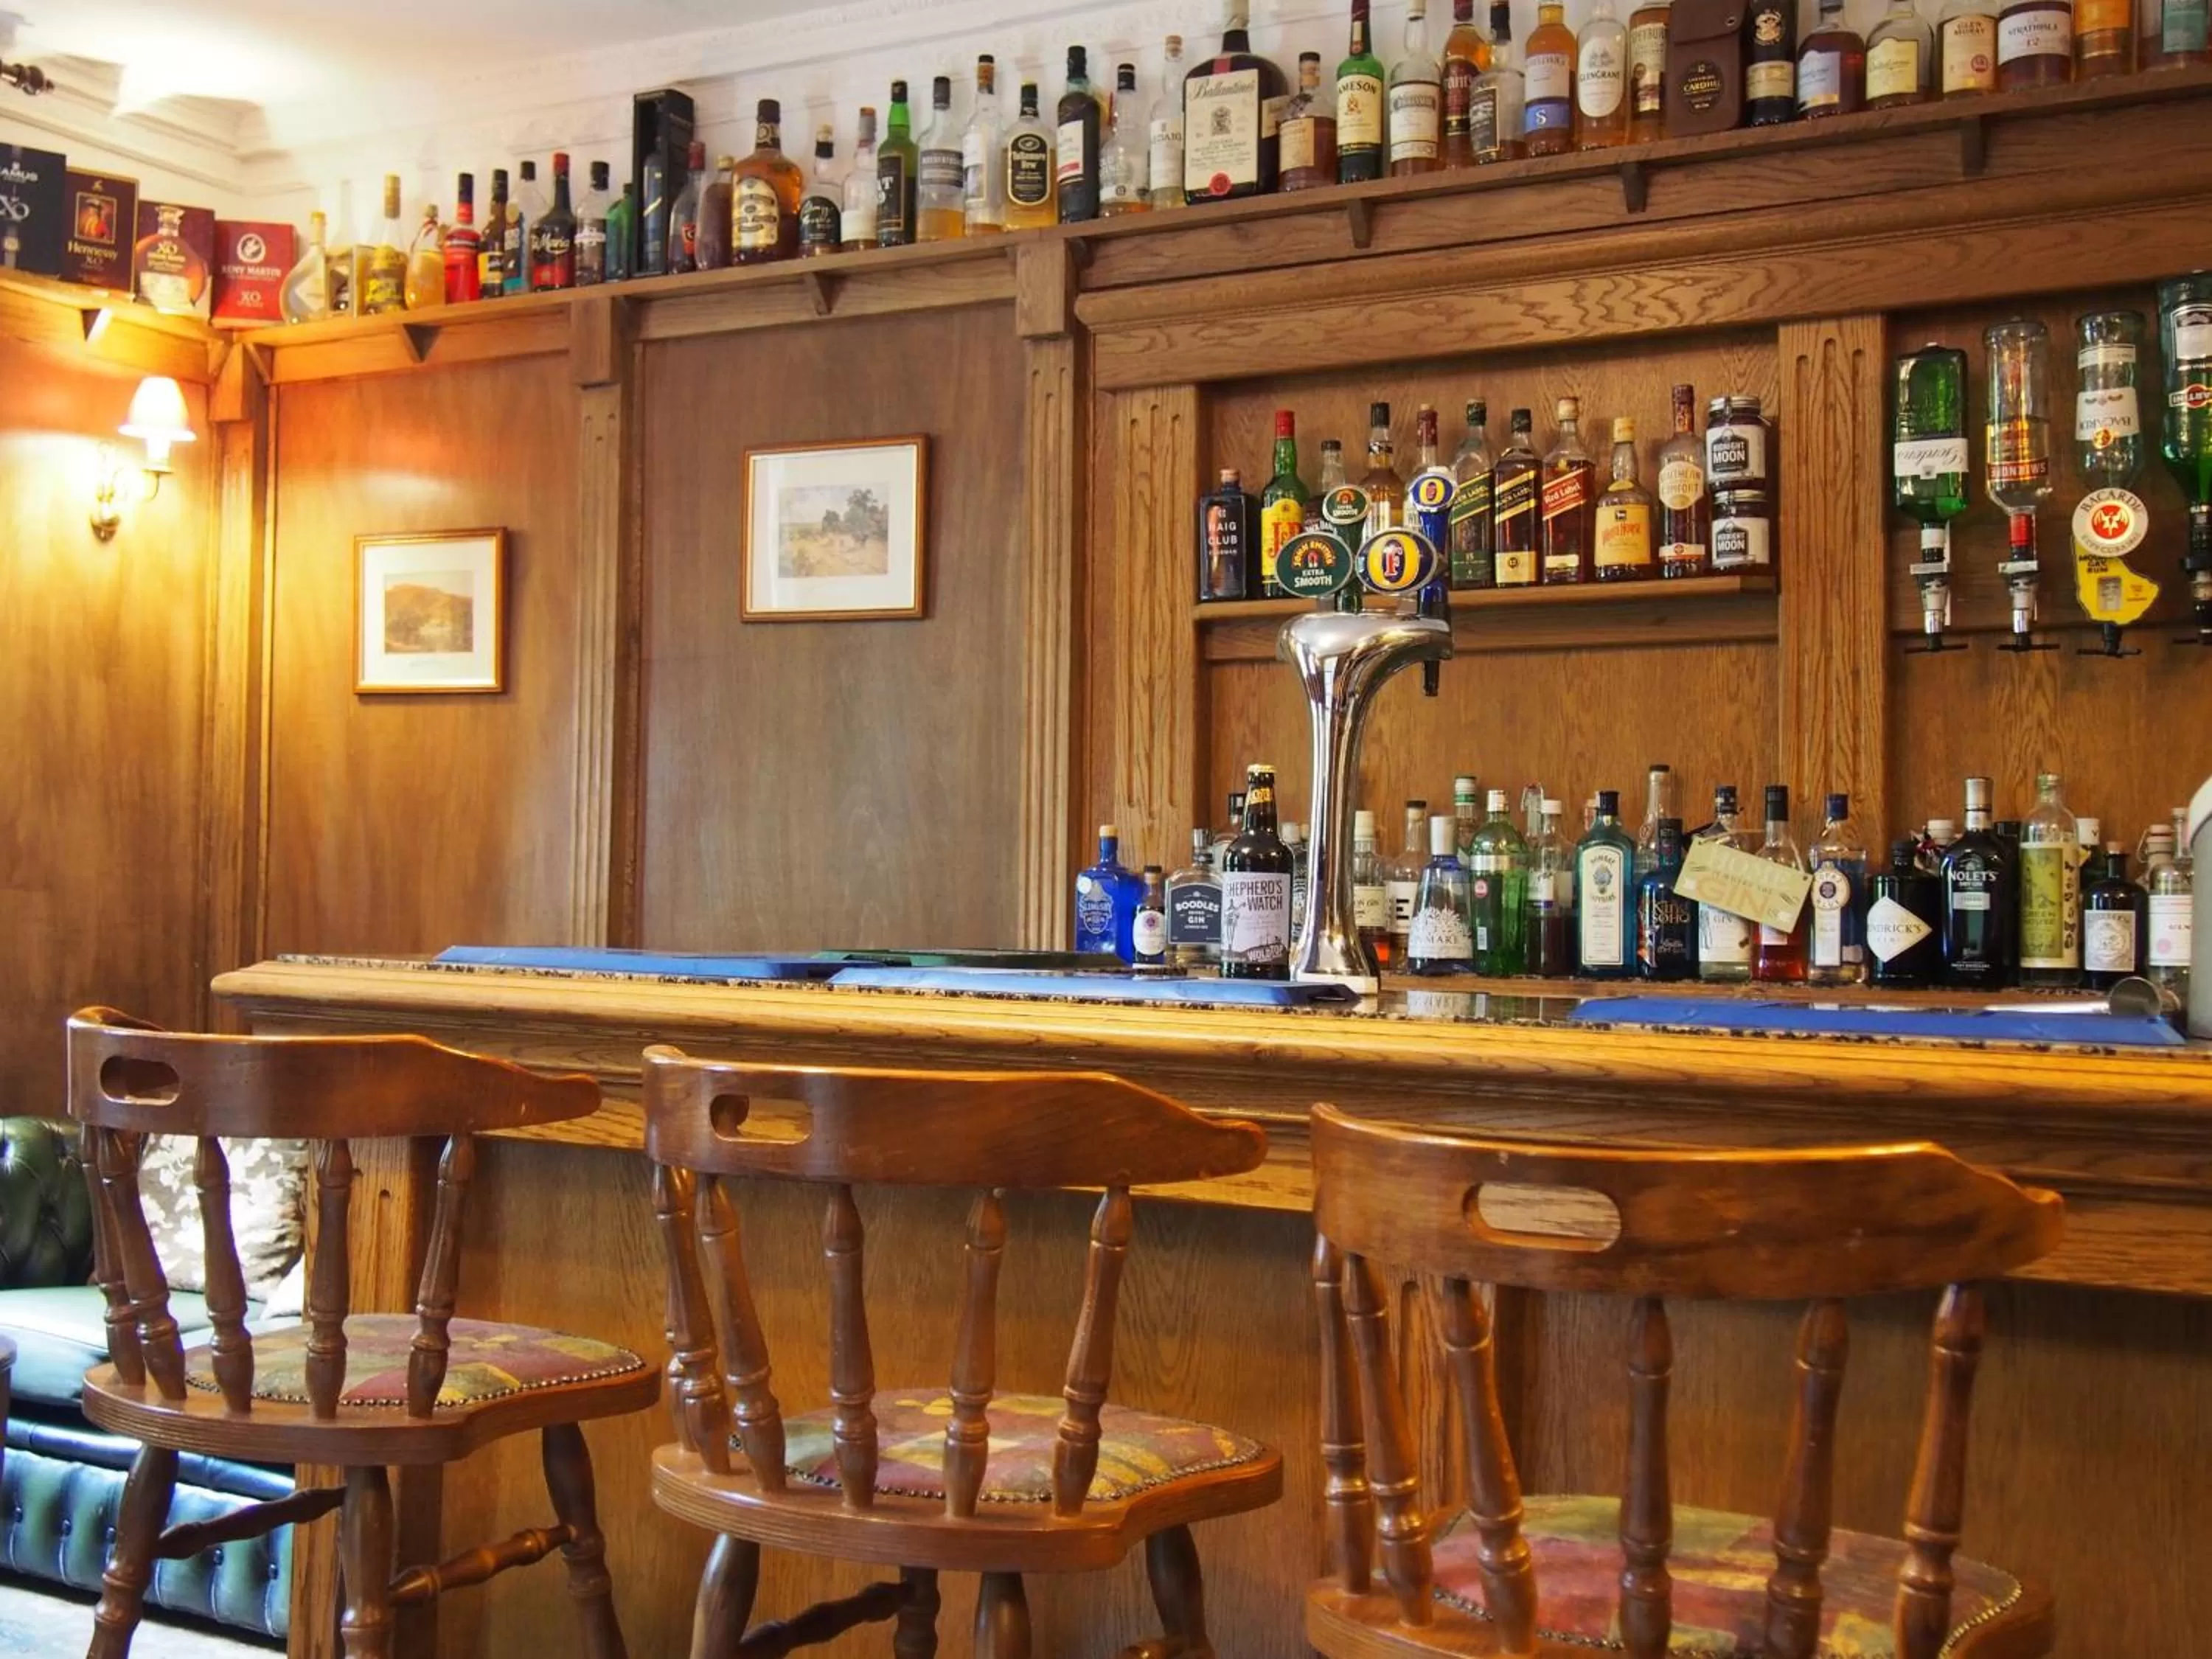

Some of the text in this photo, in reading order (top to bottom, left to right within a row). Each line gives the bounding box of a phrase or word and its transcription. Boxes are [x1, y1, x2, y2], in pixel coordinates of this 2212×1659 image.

[1713, 450, 1746, 465] MOON
[1717, 539, 1746, 552] MOON
[1294, 574, 1332, 588] SMOOTH
[1227, 879, 1283, 897] SHEPHERD'S
[1697, 874, 1770, 918] GIN
[1175, 900, 1220, 913] BOODLES
[1247, 895, 1283, 912] WATCH
[1187, 916, 1205, 925] GIN
